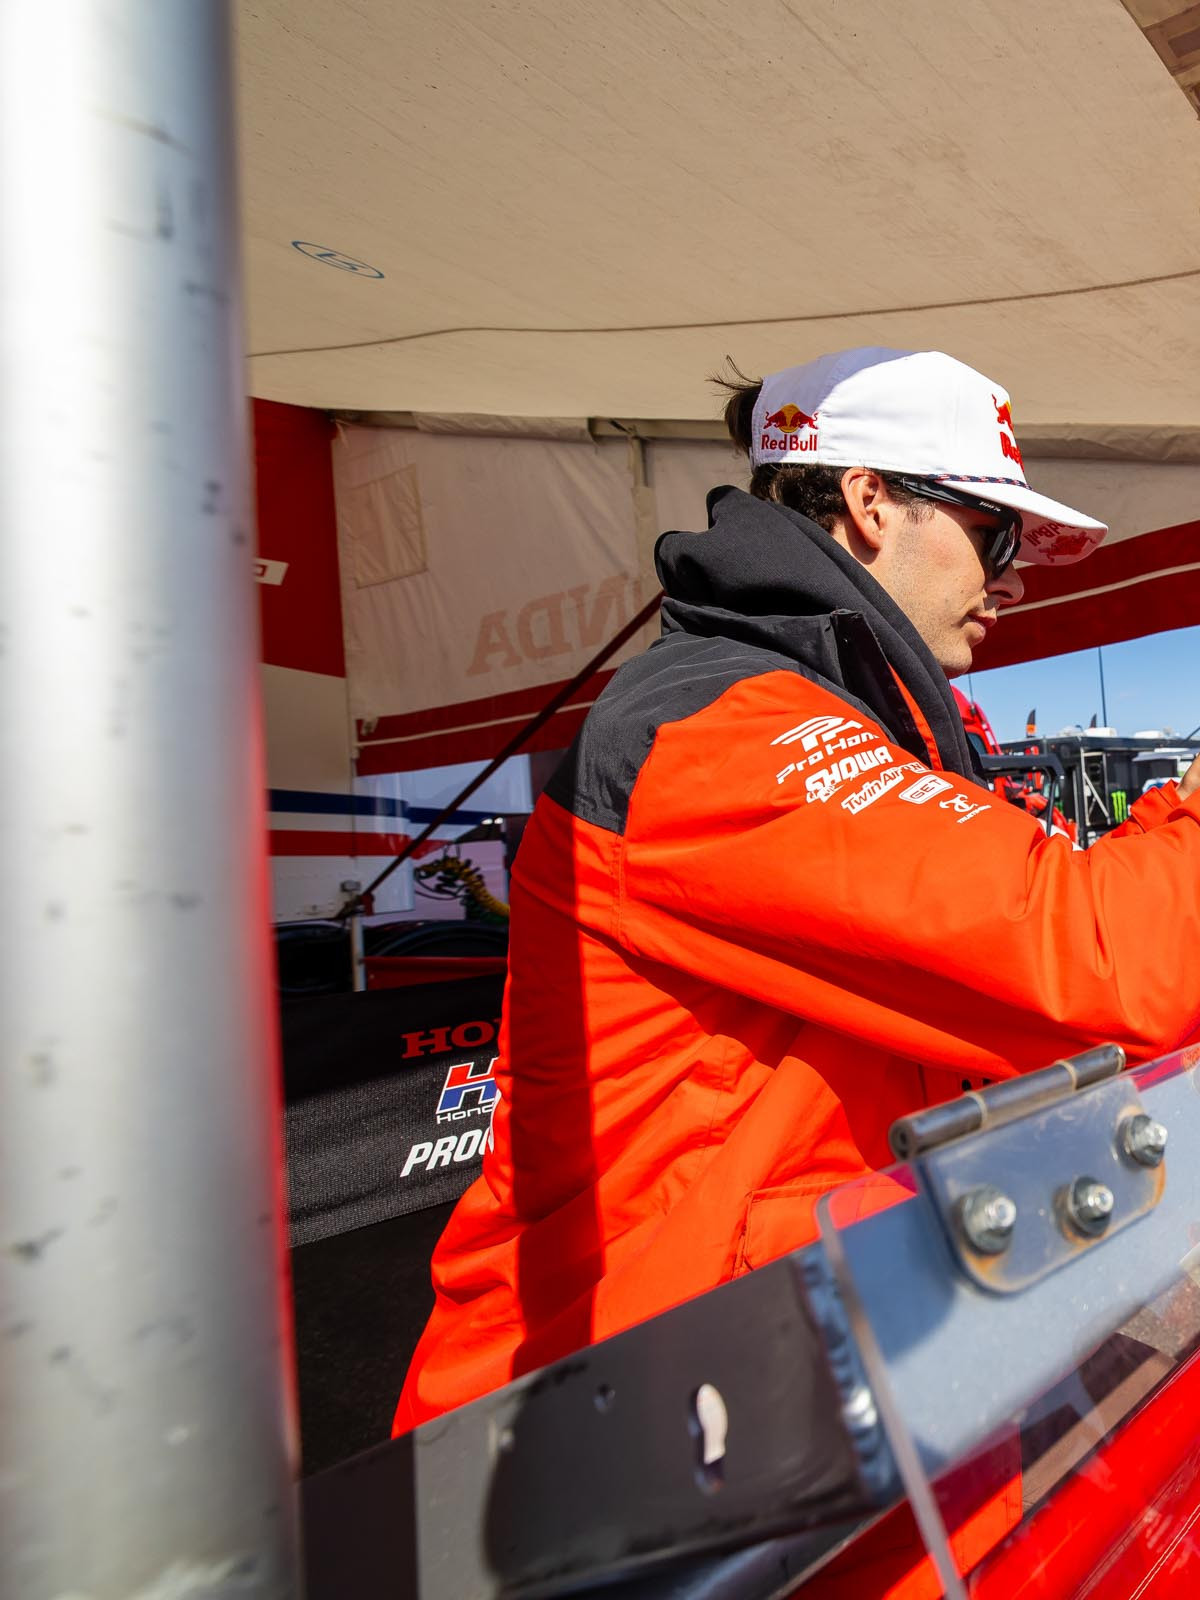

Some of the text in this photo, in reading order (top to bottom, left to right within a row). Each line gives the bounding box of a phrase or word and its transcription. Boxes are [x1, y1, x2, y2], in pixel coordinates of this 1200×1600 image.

[761, 434, 817, 452] Red Bull
[825, 732, 879, 756] Hon
[805, 745, 893, 793] SHOWA
[402, 1019, 500, 1059] HO
